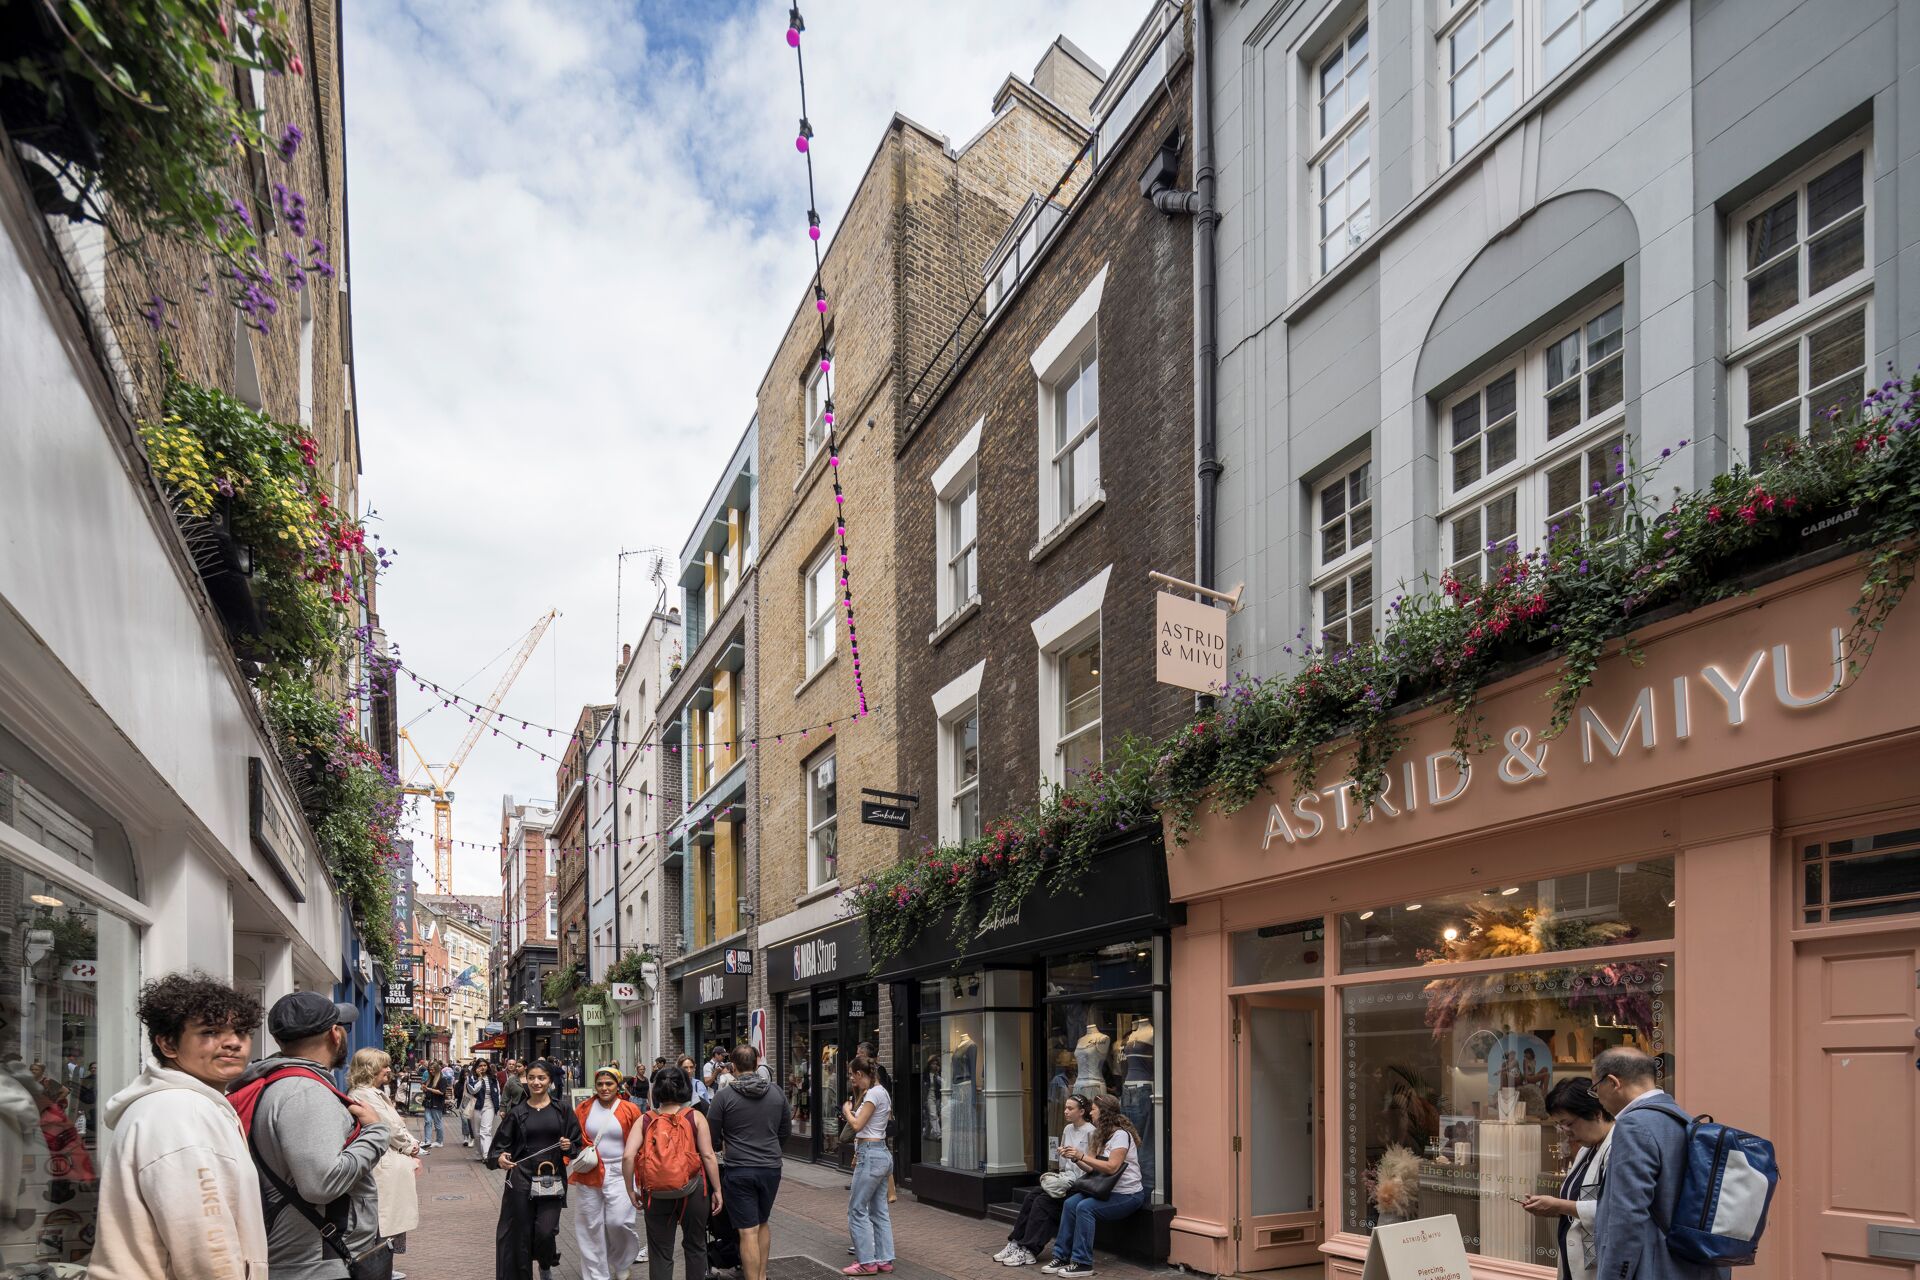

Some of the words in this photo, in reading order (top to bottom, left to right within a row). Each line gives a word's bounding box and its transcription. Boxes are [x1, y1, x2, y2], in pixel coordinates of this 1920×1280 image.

[1800, 506, 1862, 538] CARNABY
[1161, 620, 1225, 650] ASTRID
[1161, 640, 1172, 656] &
[1180, 644, 1223, 669] MIYU
[1262, 749, 1472, 851] ASTRID
[1499, 726, 1547, 785] &
[1580, 626, 1846, 764] MIYU
[737, 950, 750, 963] NBA
[737, 962, 752, 974] Store
[800, 942, 817, 979] NBA
[816, 938, 837, 975] Store
[703, 974, 713, 1003] NBA
[712, 973, 724, 1001] Store
[586, 1007, 602, 1022] pixi
[1422, 1165, 1443, 1177] The
[1446, 1167, 1492, 1183] colours
[1495, 1174, 1514, 1184] we
[1518, 1175, 1562, 1190] treasur
[1431, 1183, 1491, 1200] Celebrating
[197, 1168, 220, 1217] LUKE
[1417, 1266, 1446, 1276] Piercing,
